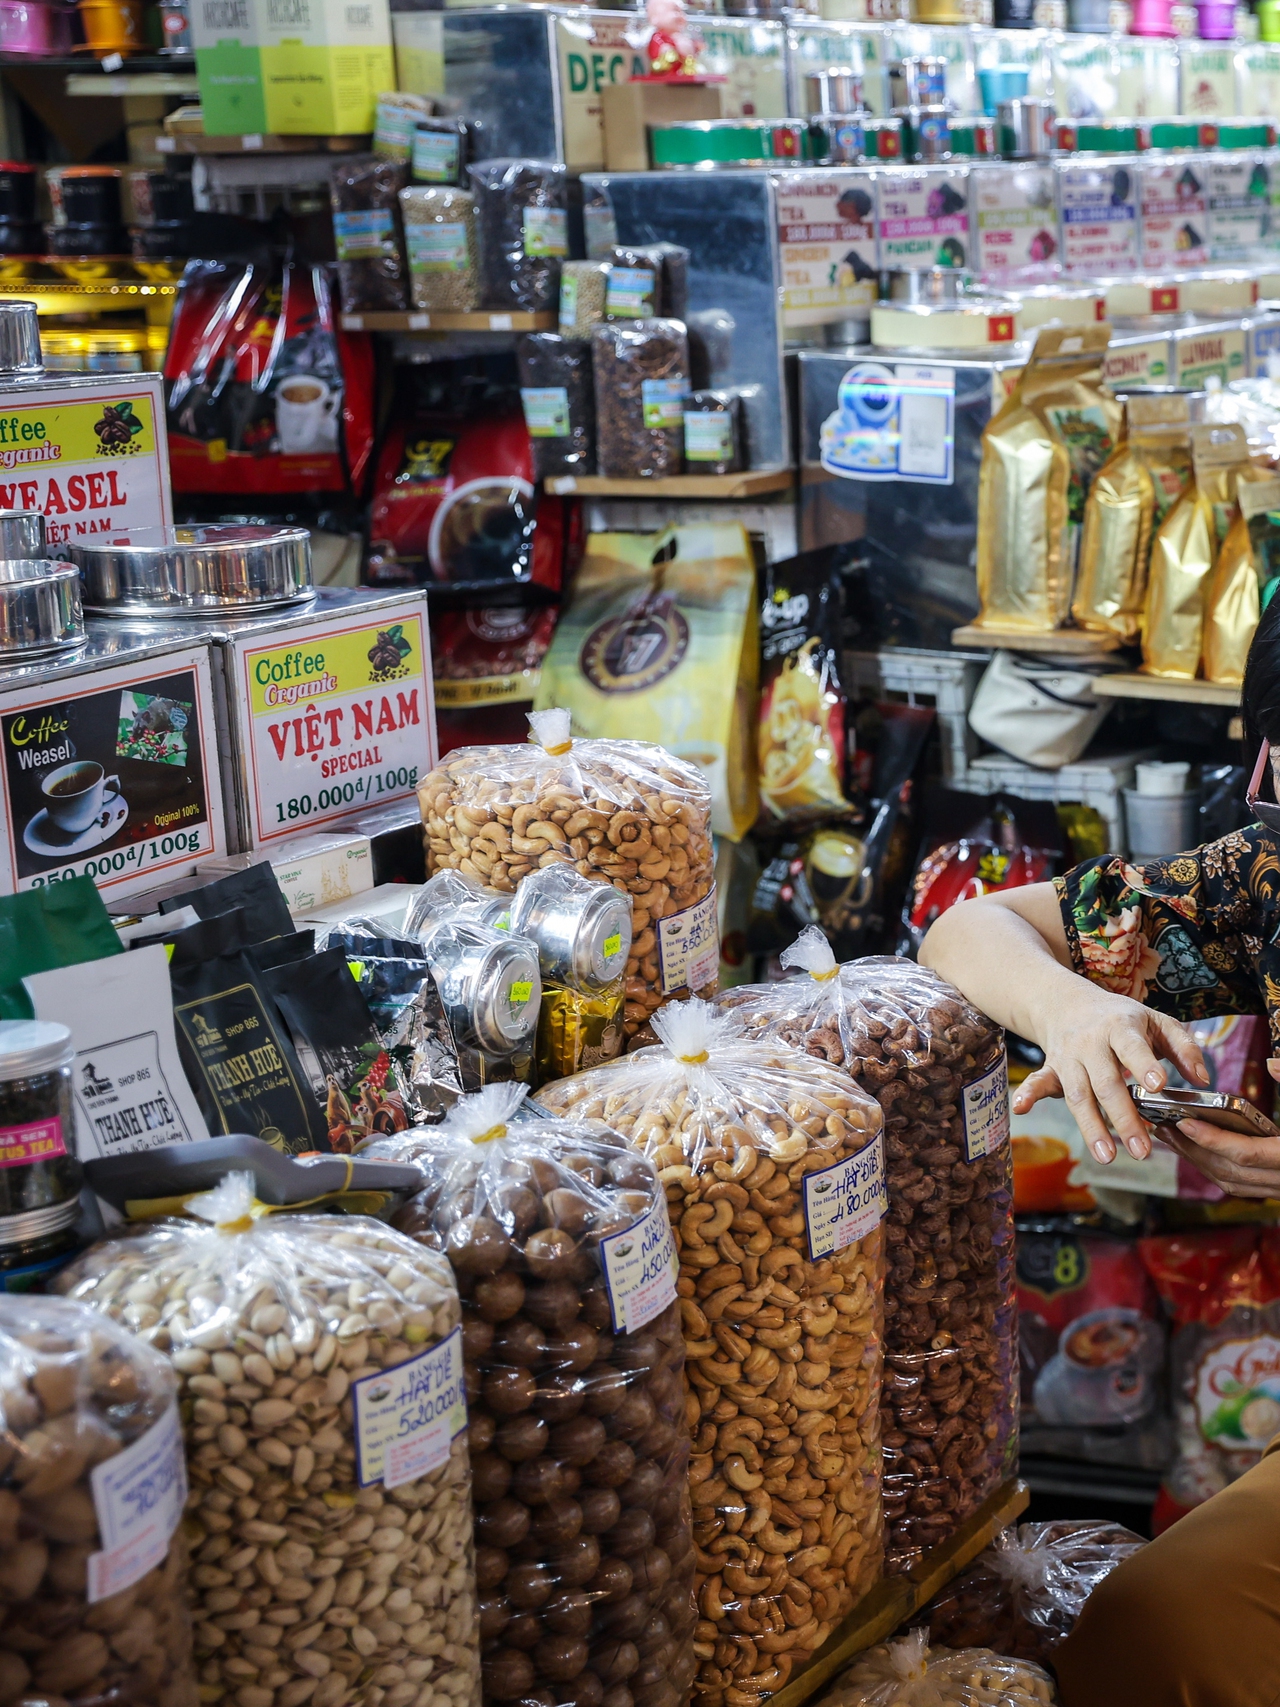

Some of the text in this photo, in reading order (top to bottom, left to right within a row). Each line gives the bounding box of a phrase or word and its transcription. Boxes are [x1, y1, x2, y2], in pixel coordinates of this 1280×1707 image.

[75, 517, 112, 535] NAM
[255, 652, 325, 685] Coffee
[264, 672, 337, 707] Organic
[10, 715, 70, 746] Coffee
[267, 688, 420, 762] VIỆT NAM
[18, 740, 70, 770] Weasel
[321, 746, 382, 779] SPECIAL
[154, 803, 200, 826] Original 100%
[225, 1016, 260, 1038] SHOP 865
[118, 1067, 151, 1087] SHOP 865
[207, 1037, 283, 1091] THANH HUỆ
[95, 1089, 175, 1145] THANH HUỆ
[20, 1129, 47, 1142] SEN
[30, 1138, 55, 1155] TEA
